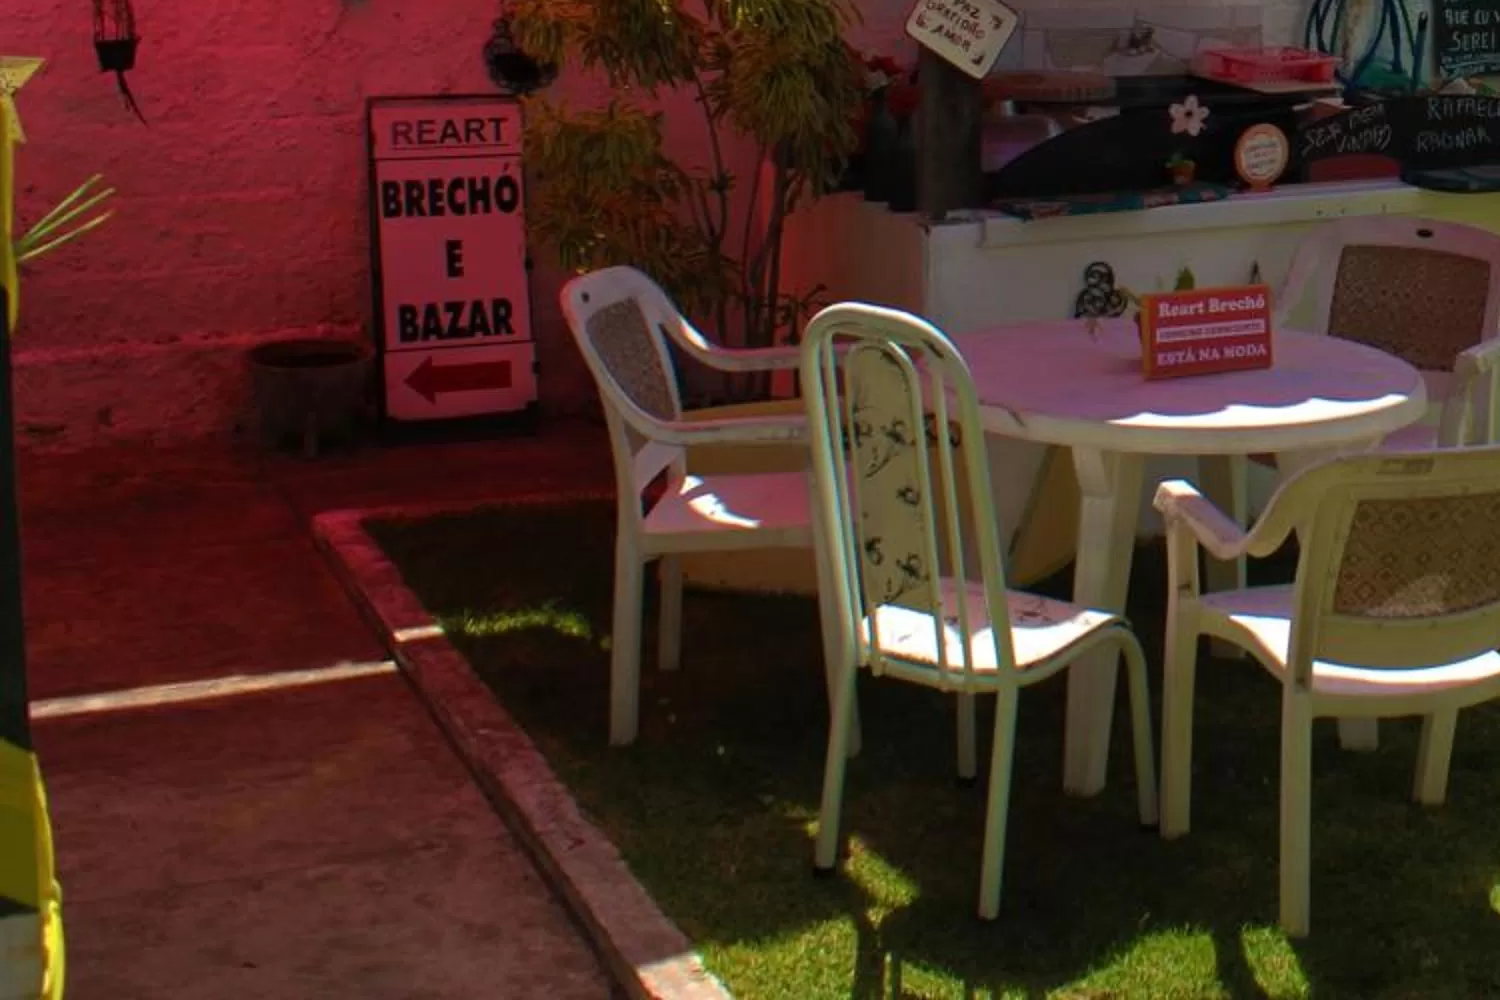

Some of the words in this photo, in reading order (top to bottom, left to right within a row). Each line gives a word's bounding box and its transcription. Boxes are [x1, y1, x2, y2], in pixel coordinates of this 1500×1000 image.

[391, 117, 508, 146] REART
[381, 164, 519, 219] BRECHÓ
[446, 240, 464, 278] E
[398, 298, 515, 343] BAZAR
[1158, 301, 1205, 318] Reart
[1208, 294, 1265, 313] Brechó
[1158, 346, 1195, 367] ESTÁ
[1199, 347, 1220, 361] NA
[1223, 344, 1267, 358] MODA
